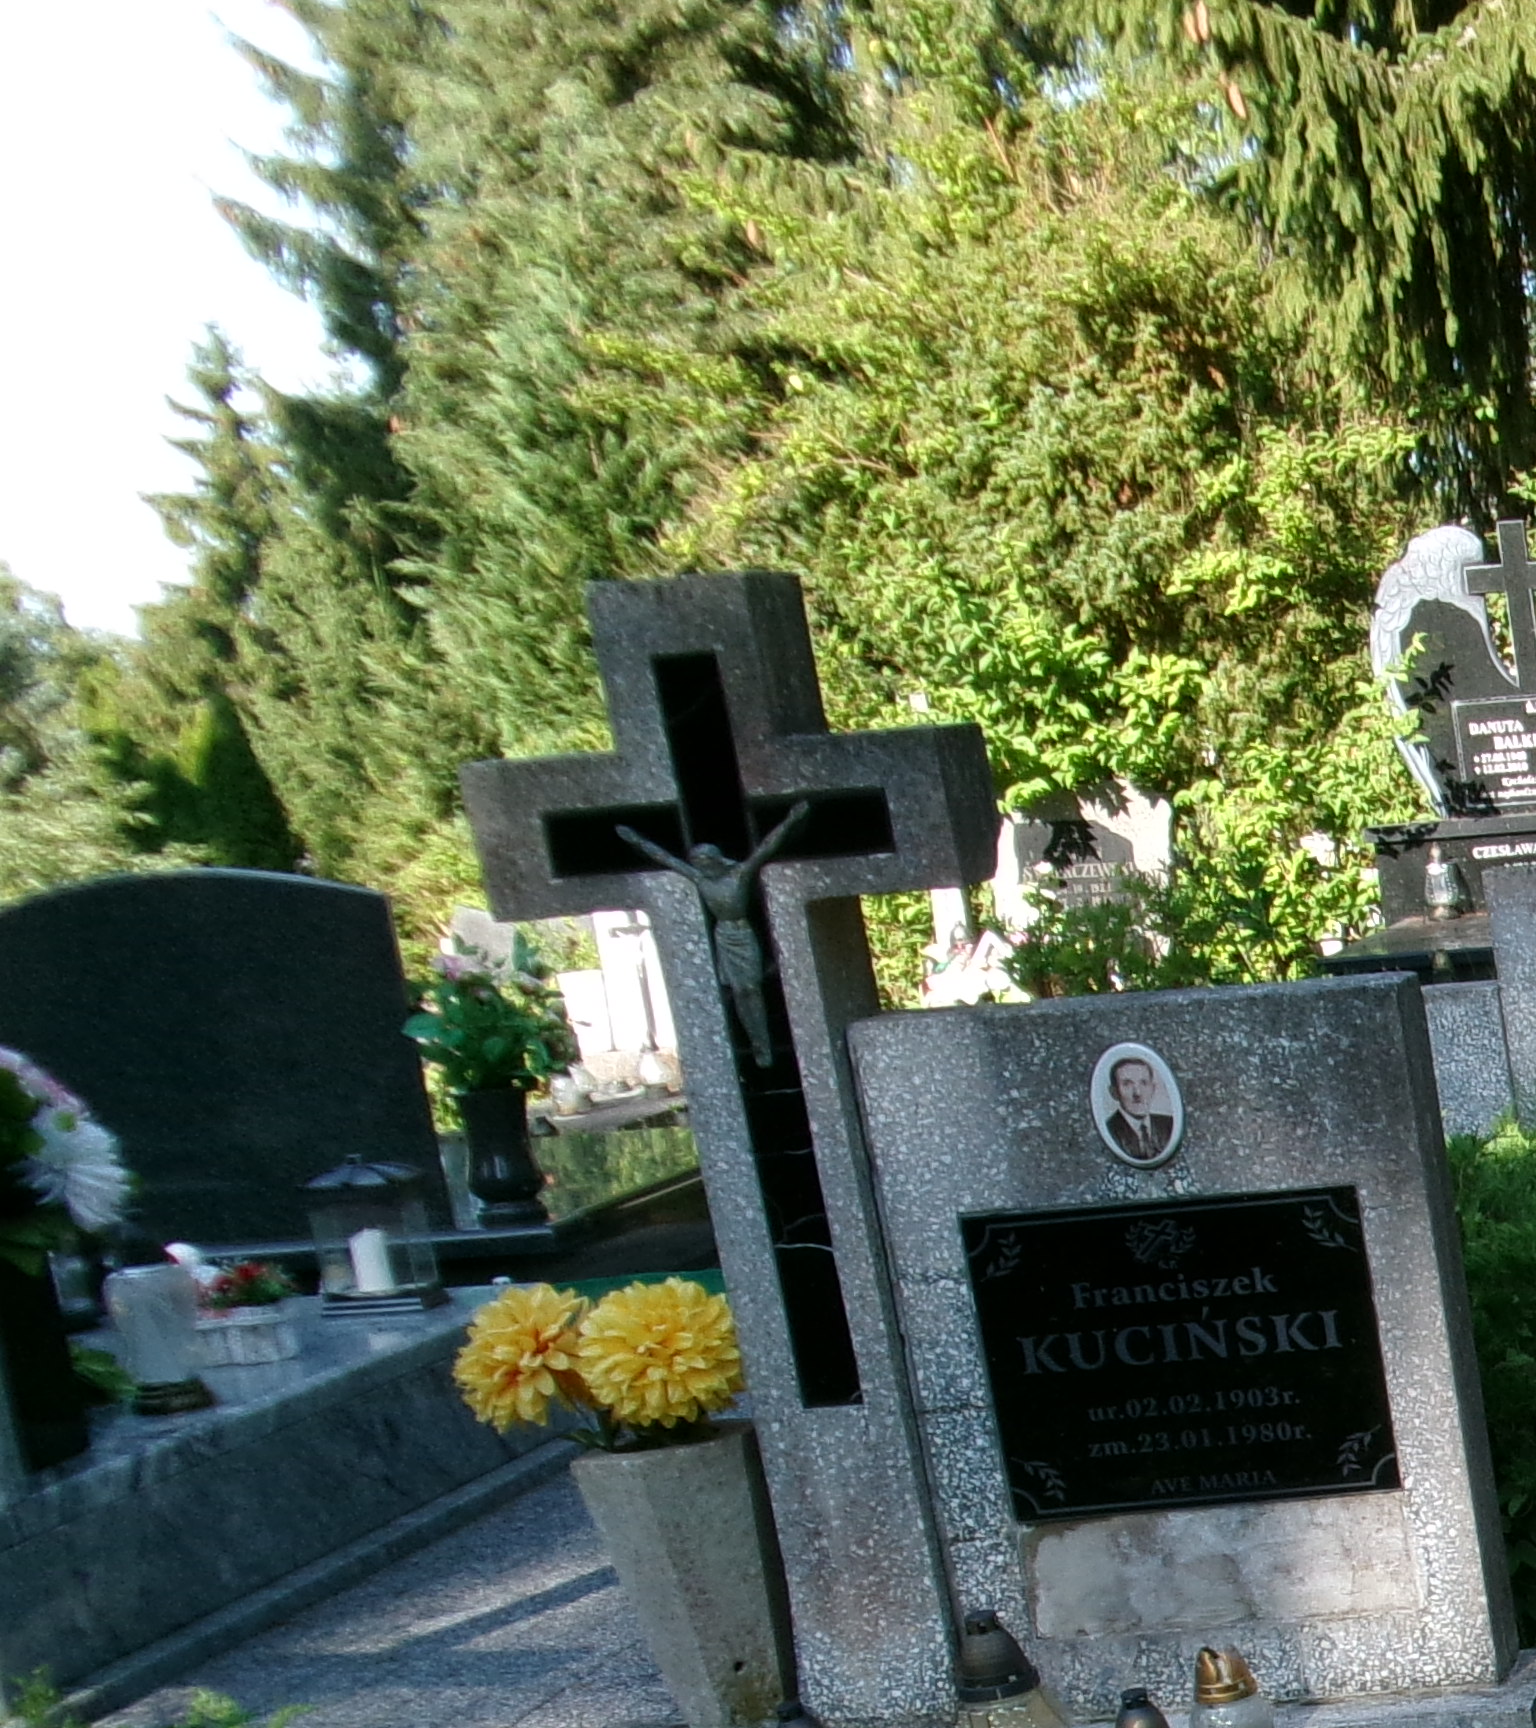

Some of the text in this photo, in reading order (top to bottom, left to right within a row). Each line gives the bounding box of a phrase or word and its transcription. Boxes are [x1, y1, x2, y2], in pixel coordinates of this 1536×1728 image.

[1468, 719, 1525, 736] DANUTA
[1069, 1266, 1279, 1310] Franciszek
[1016, 1305, 1344, 1375] KUCIŃSKI
[1086, 1385, 1301, 1423] ur.02.02.1903r.
[1087, 1419, 1312, 1458] zm.23.01.1980r.
[1151, 1469, 1278, 1496] AVE MARIA
